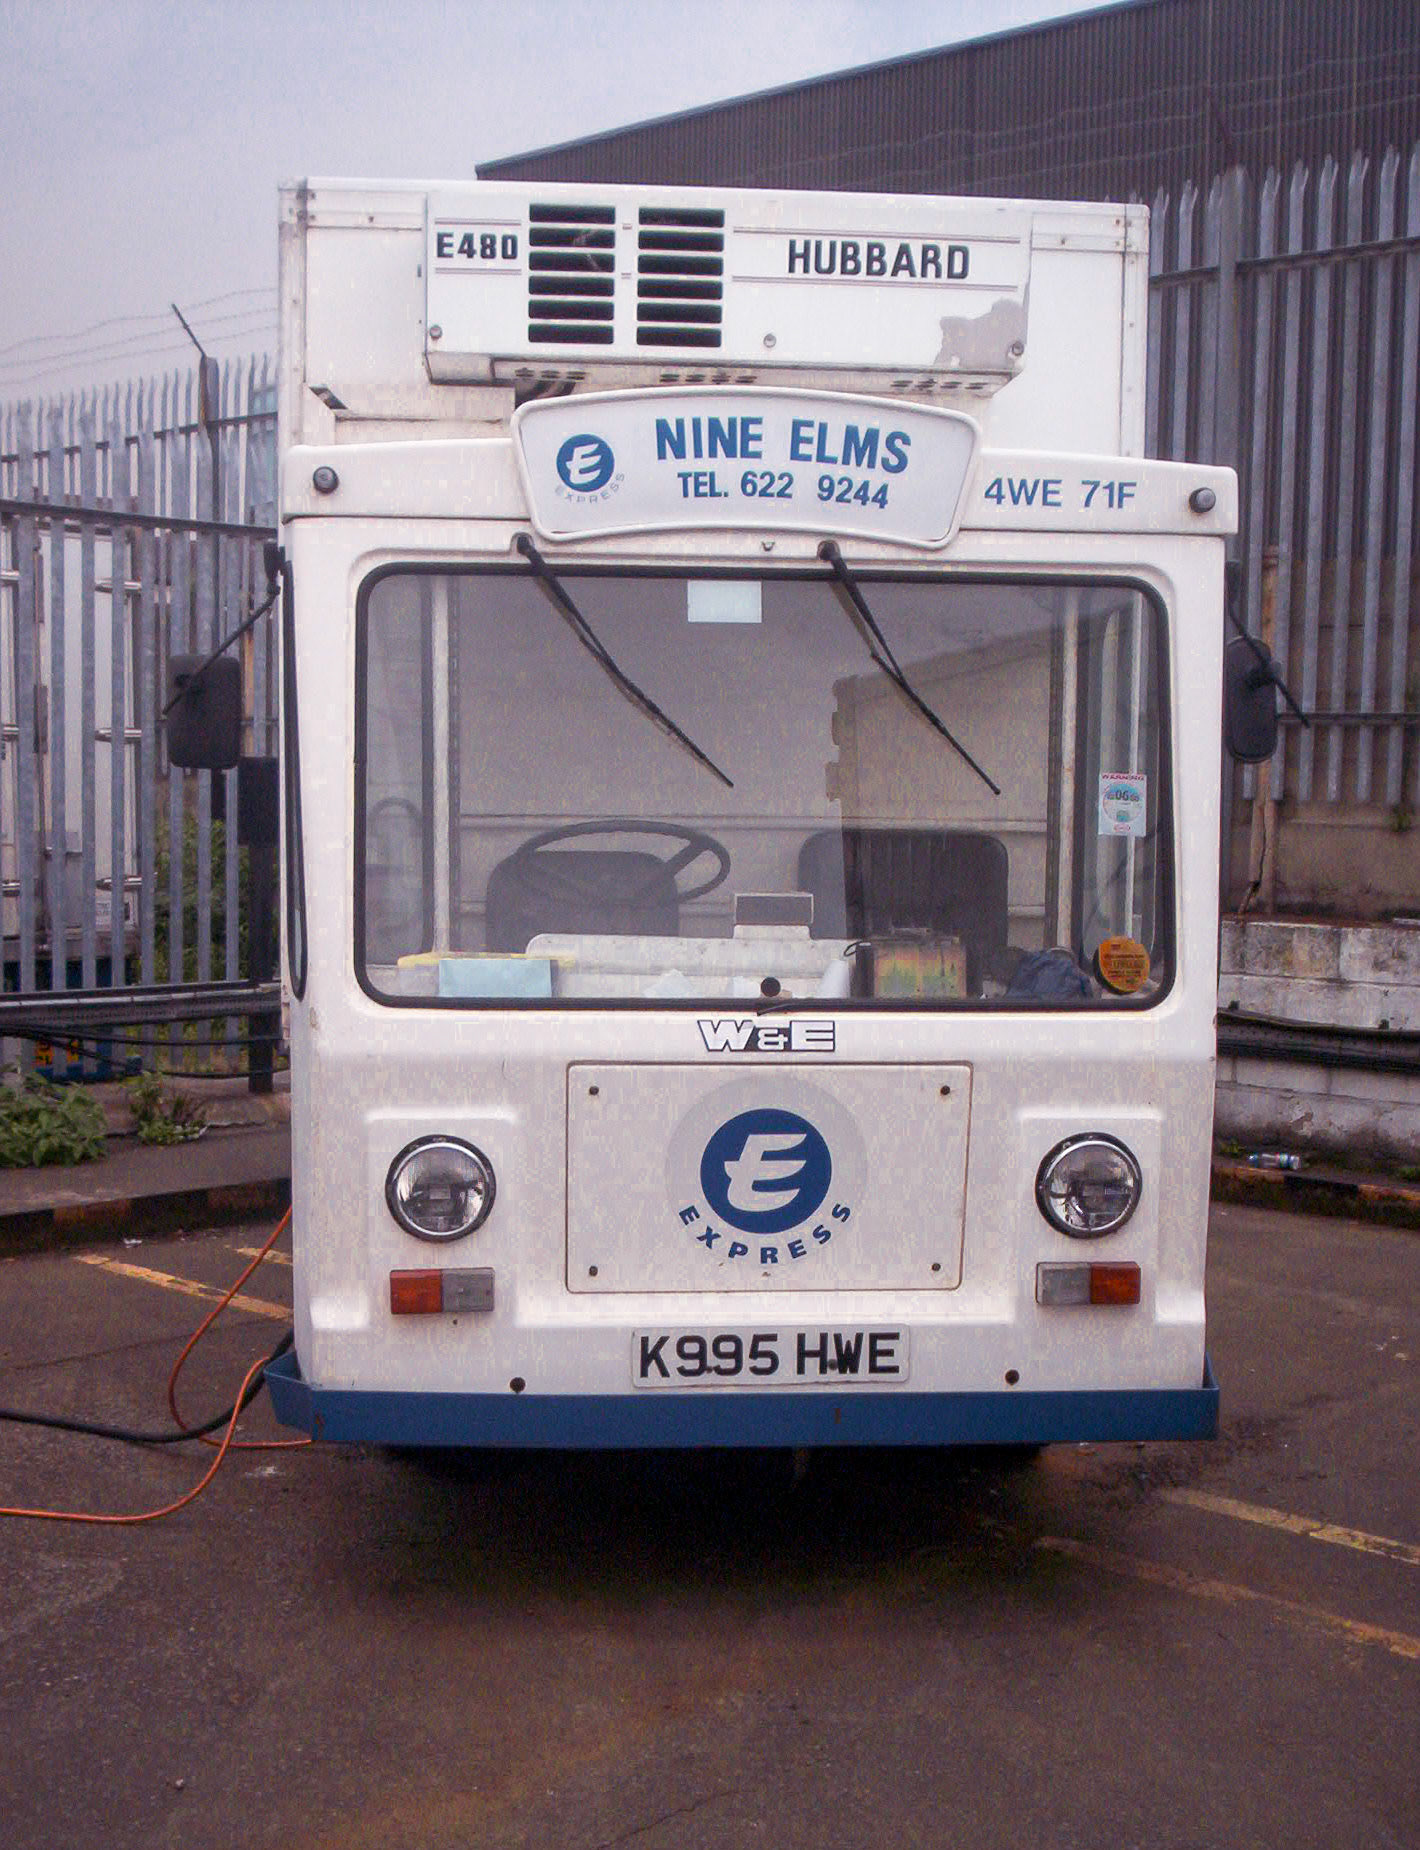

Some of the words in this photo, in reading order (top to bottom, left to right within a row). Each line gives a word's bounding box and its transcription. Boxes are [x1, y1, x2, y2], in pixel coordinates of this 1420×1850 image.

[436, 232, 518, 260] E480
[788, 239, 970, 280] HUBBARD
[655, 416, 763, 461] NINE
[789, 418, 912, 474] ELMS
[677, 471, 729, 498] TEL.
[740, 470, 794, 499] 622
[817, 474, 889, 509] 9244
[984, 477, 1062, 507] 4WE
[1081, 479, 1137, 509] 71F
[697, 1019, 835, 1053] W&E
[679, 1203, 851, 1264] EXPRESS
[639, 1333, 780, 1378] K995
[796, 1331, 900, 1376] HWE
